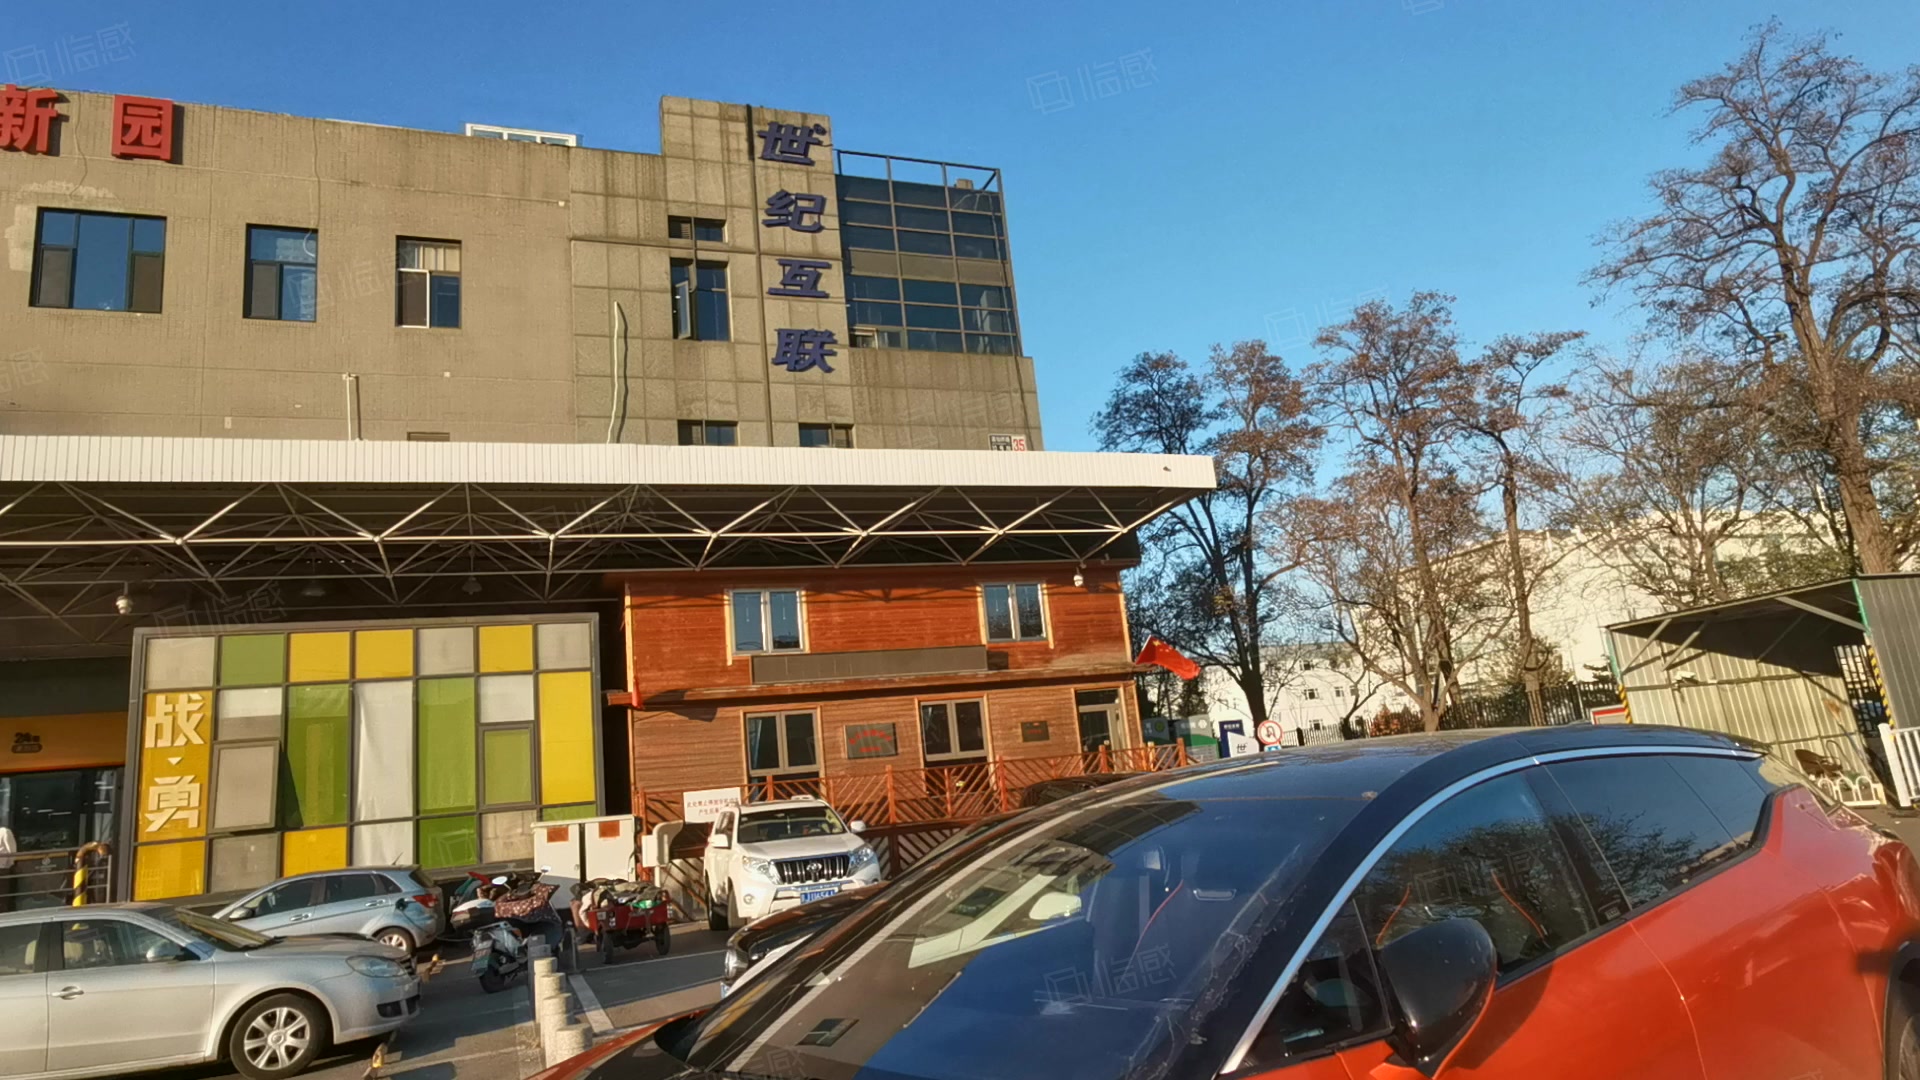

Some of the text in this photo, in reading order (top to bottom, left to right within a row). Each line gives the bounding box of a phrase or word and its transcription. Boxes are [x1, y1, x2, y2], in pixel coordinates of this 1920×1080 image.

[0, 84, 173, 160] 新园
[757, 122, 838, 373] 世纪互联
[1013, 438, 1025, 451] 35
